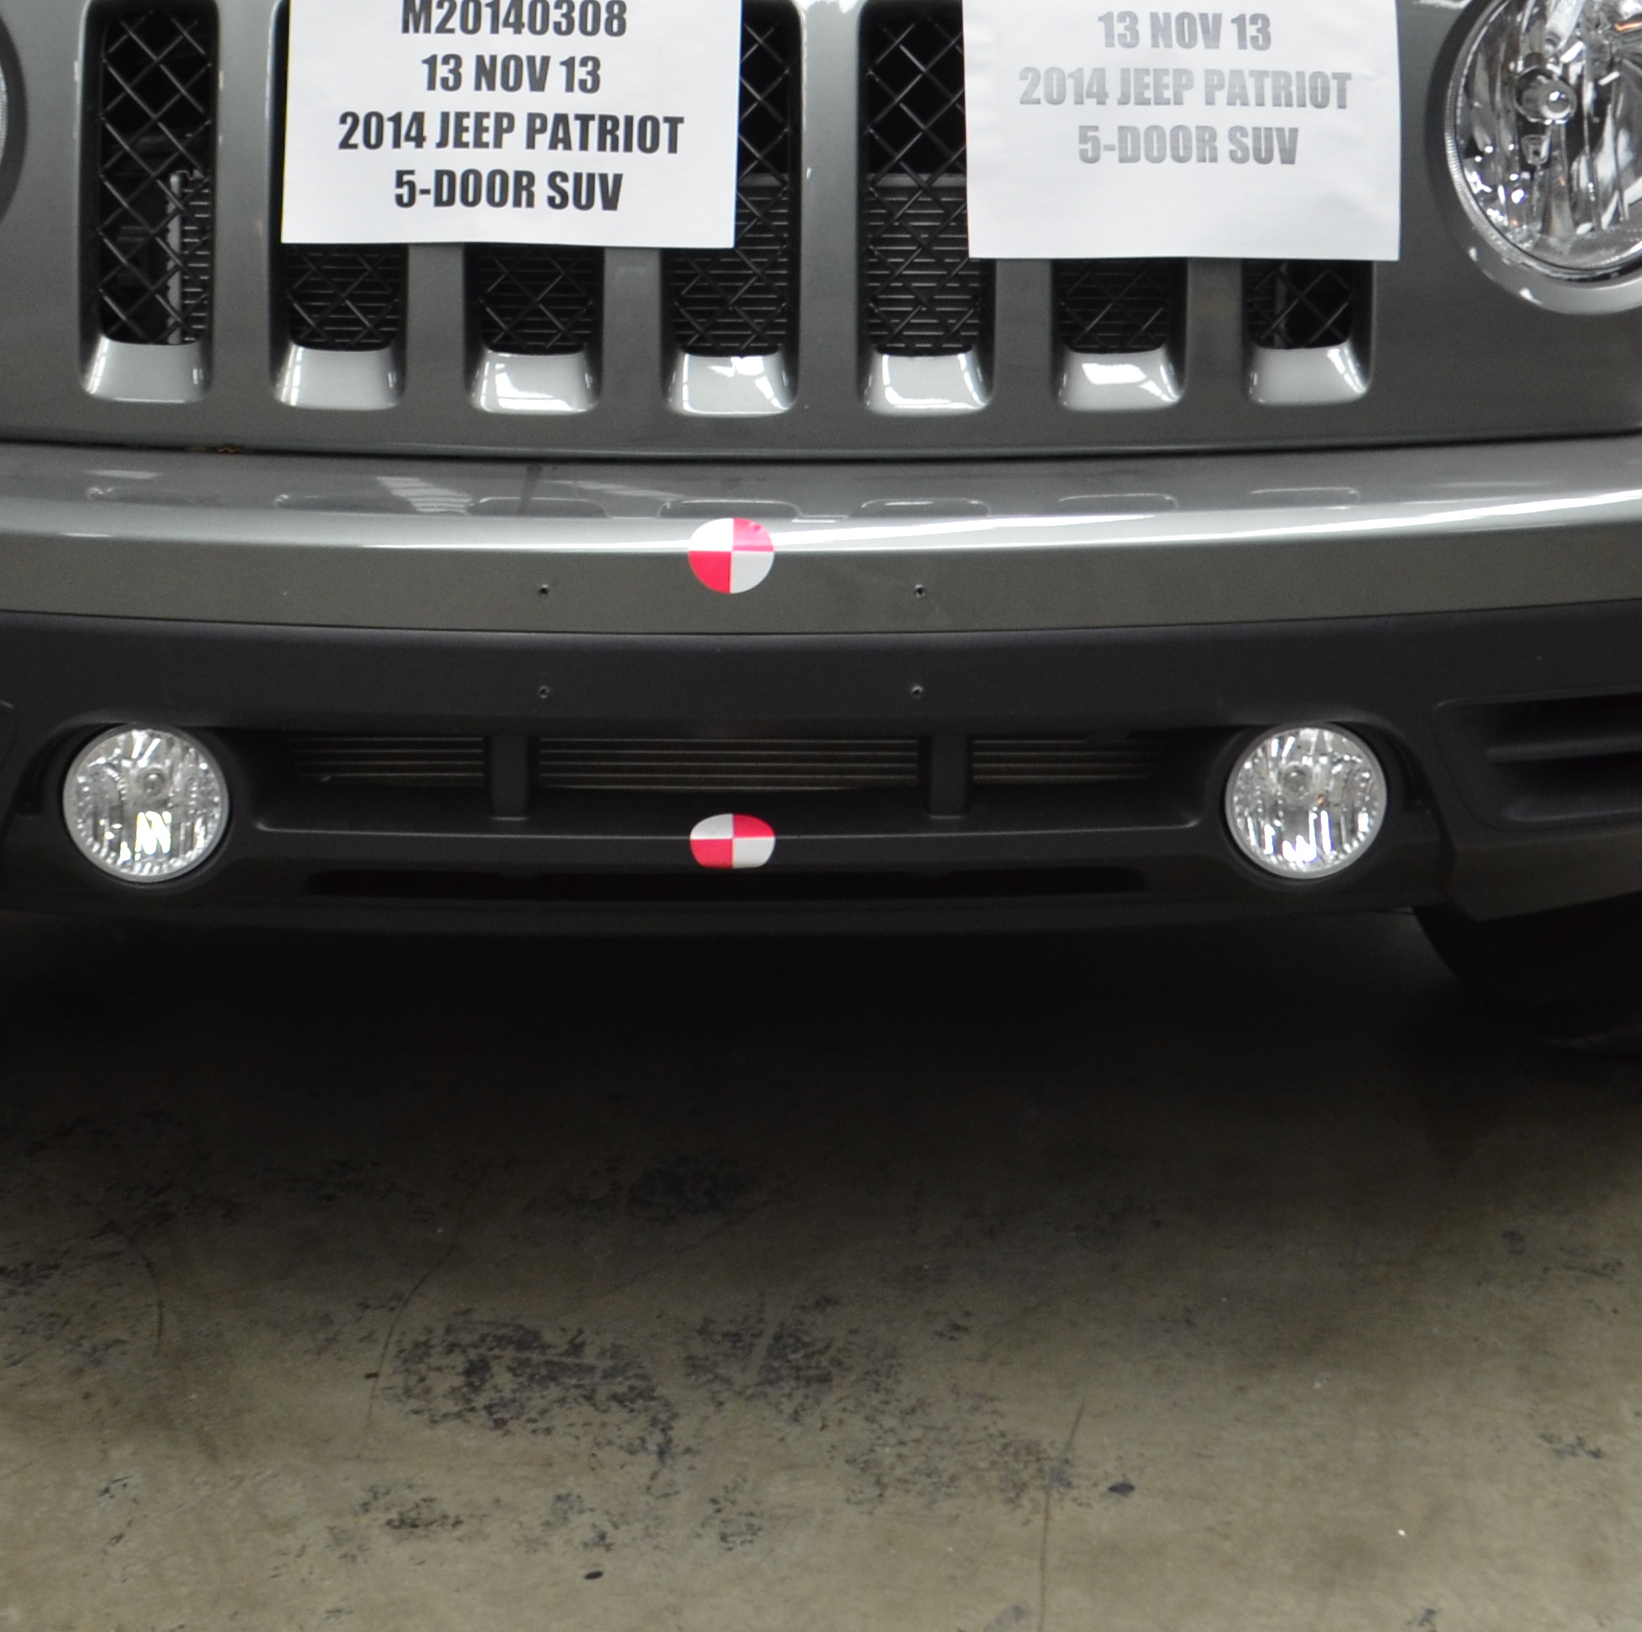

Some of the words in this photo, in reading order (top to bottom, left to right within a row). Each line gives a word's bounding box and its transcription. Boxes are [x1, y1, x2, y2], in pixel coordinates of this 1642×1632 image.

[1097, 11, 1140, 49] 13
[1149, 11, 1223, 50] NOV
[1230, 12, 1272, 52] 13
[421, 53, 463, 92] 13
[473, 53, 552, 93] NOV
[559, 55, 601, 94] 13
[1019, 66, 1109, 106] 2014
[1116, 67, 1194, 106] JEEP
[1204, 69, 1353, 110] PATRIOT
[338, 110, 427, 151] 2014
[435, 111, 516, 150] JEEP
[525, 112, 685, 155] PATRIOT
[1078, 124, 1219, 165] 5-DOOR
[1227, 125, 1299, 166] SUV
[394, 168, 536, 209] 5-DOOR
[546, 170, 624, 212] SUV
